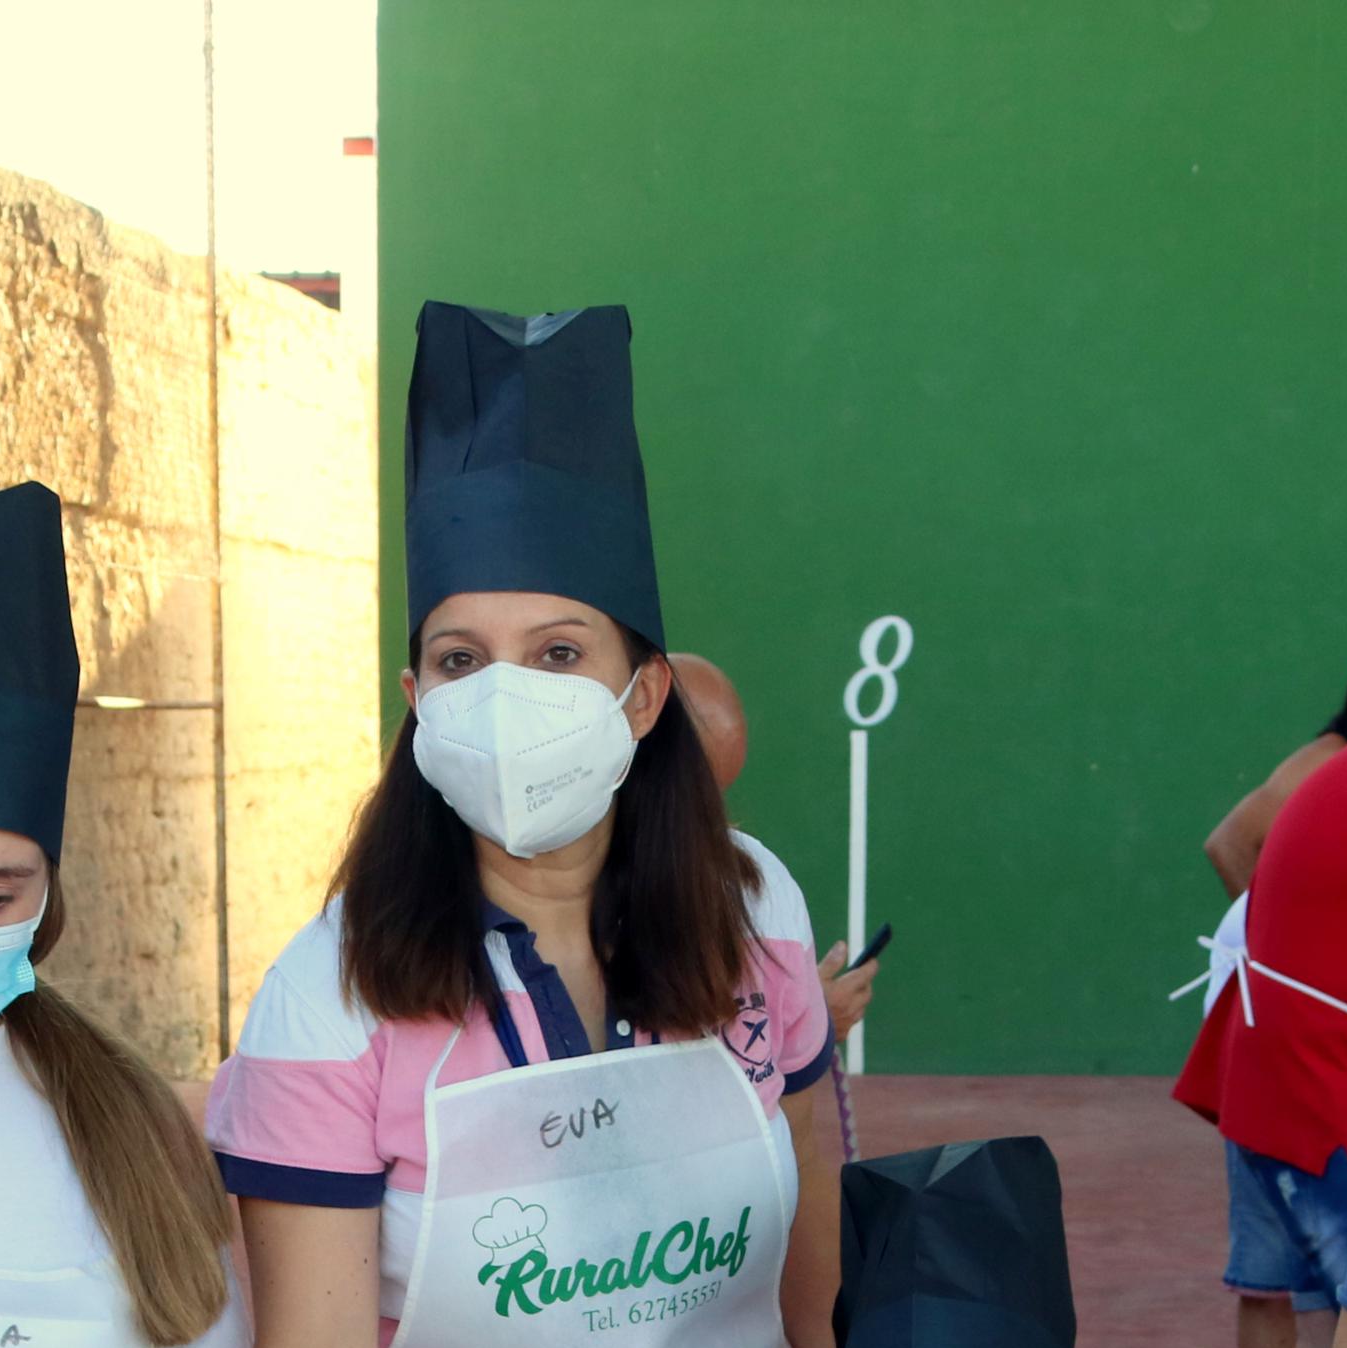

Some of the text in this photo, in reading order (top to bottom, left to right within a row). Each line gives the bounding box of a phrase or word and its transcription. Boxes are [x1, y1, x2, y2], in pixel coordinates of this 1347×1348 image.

[843, 614, 914, 727] 8
[539, 1097, 621, 1149] EVA
[478, 1205, 752, 1318] RuralChef
[582, 1280, 724, 1333] Tel. 627455551
